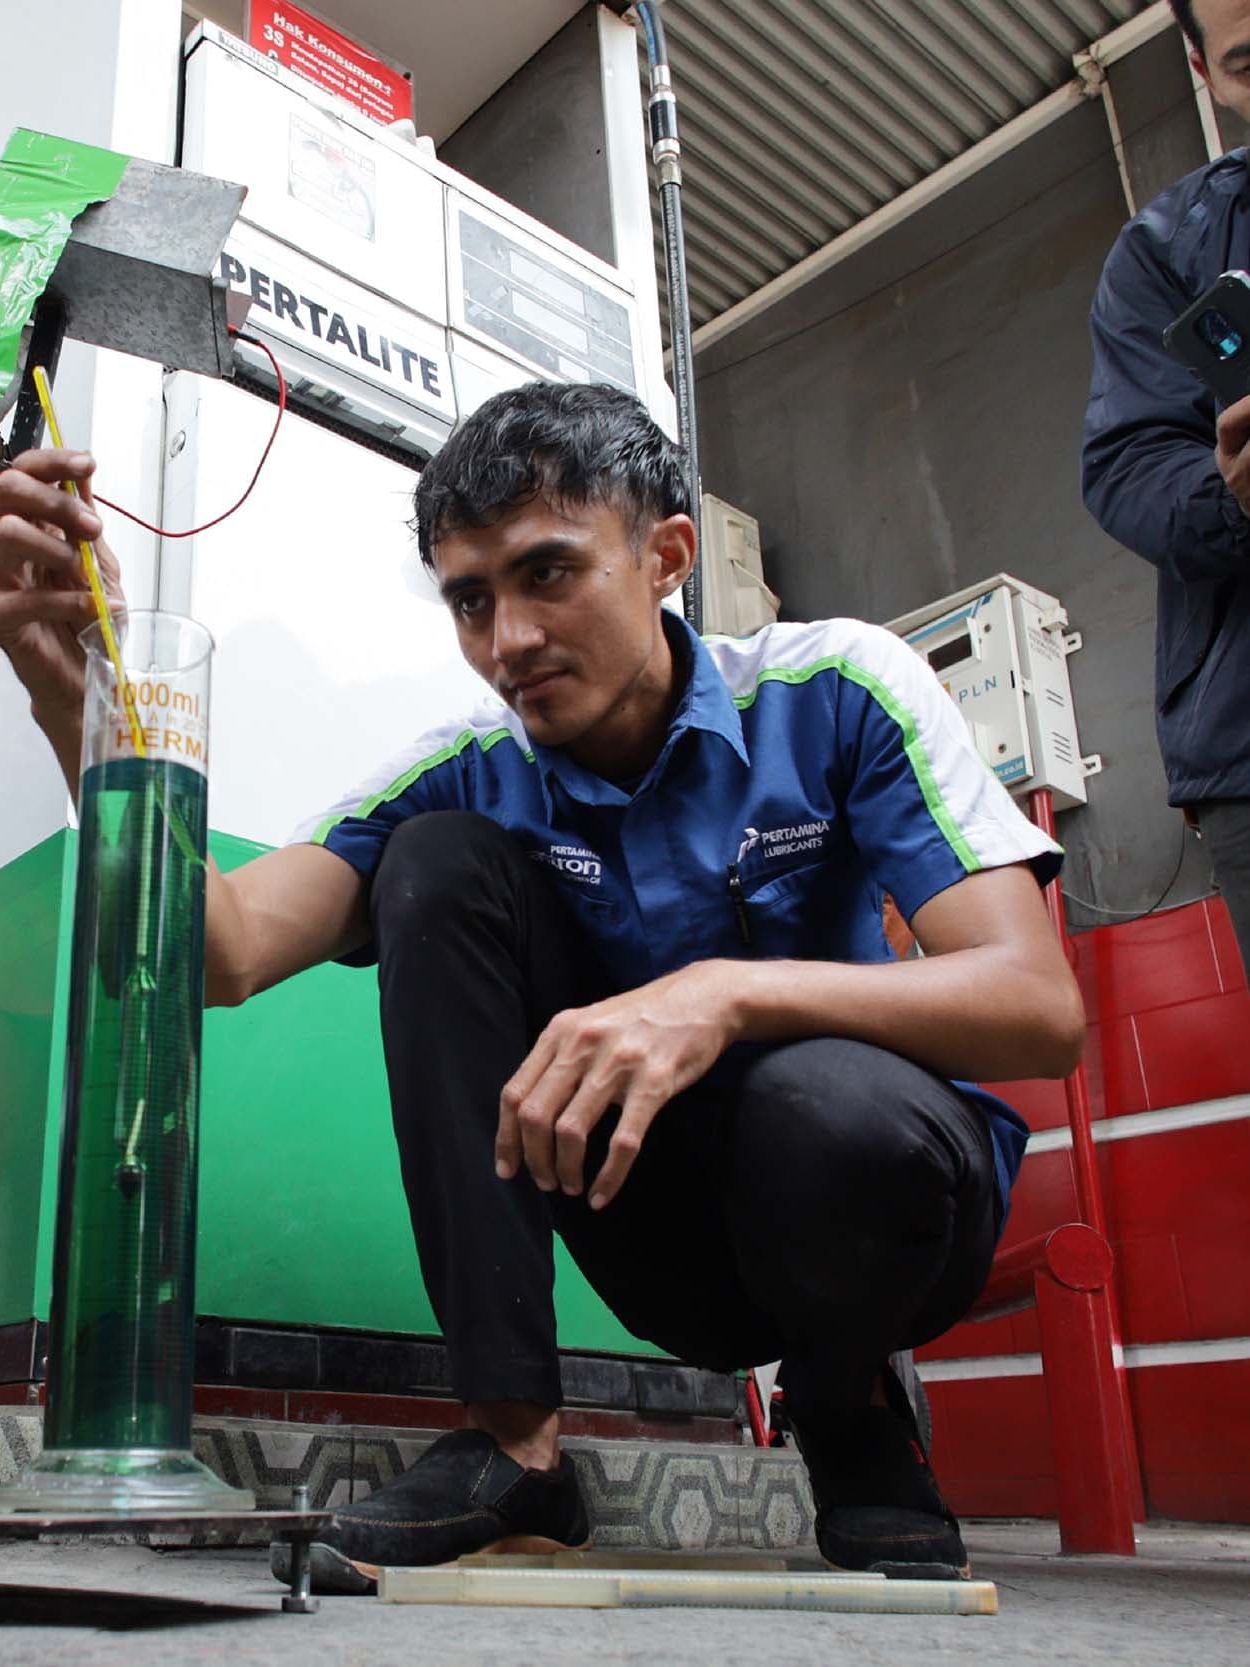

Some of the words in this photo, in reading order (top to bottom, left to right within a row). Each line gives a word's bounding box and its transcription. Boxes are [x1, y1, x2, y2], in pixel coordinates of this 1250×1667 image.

[263, 24, 285, 48] 3S
[273, 12, 305, 41] Hak
[221, 252, 442, 398] PERTALITE
[958, 675, 997, 704] PLN
[116, 727, 208, 768] HERM
[762, 820, 830, 844] PERTAMINA
[764, 836, 823, 858] LUBRICANTS
